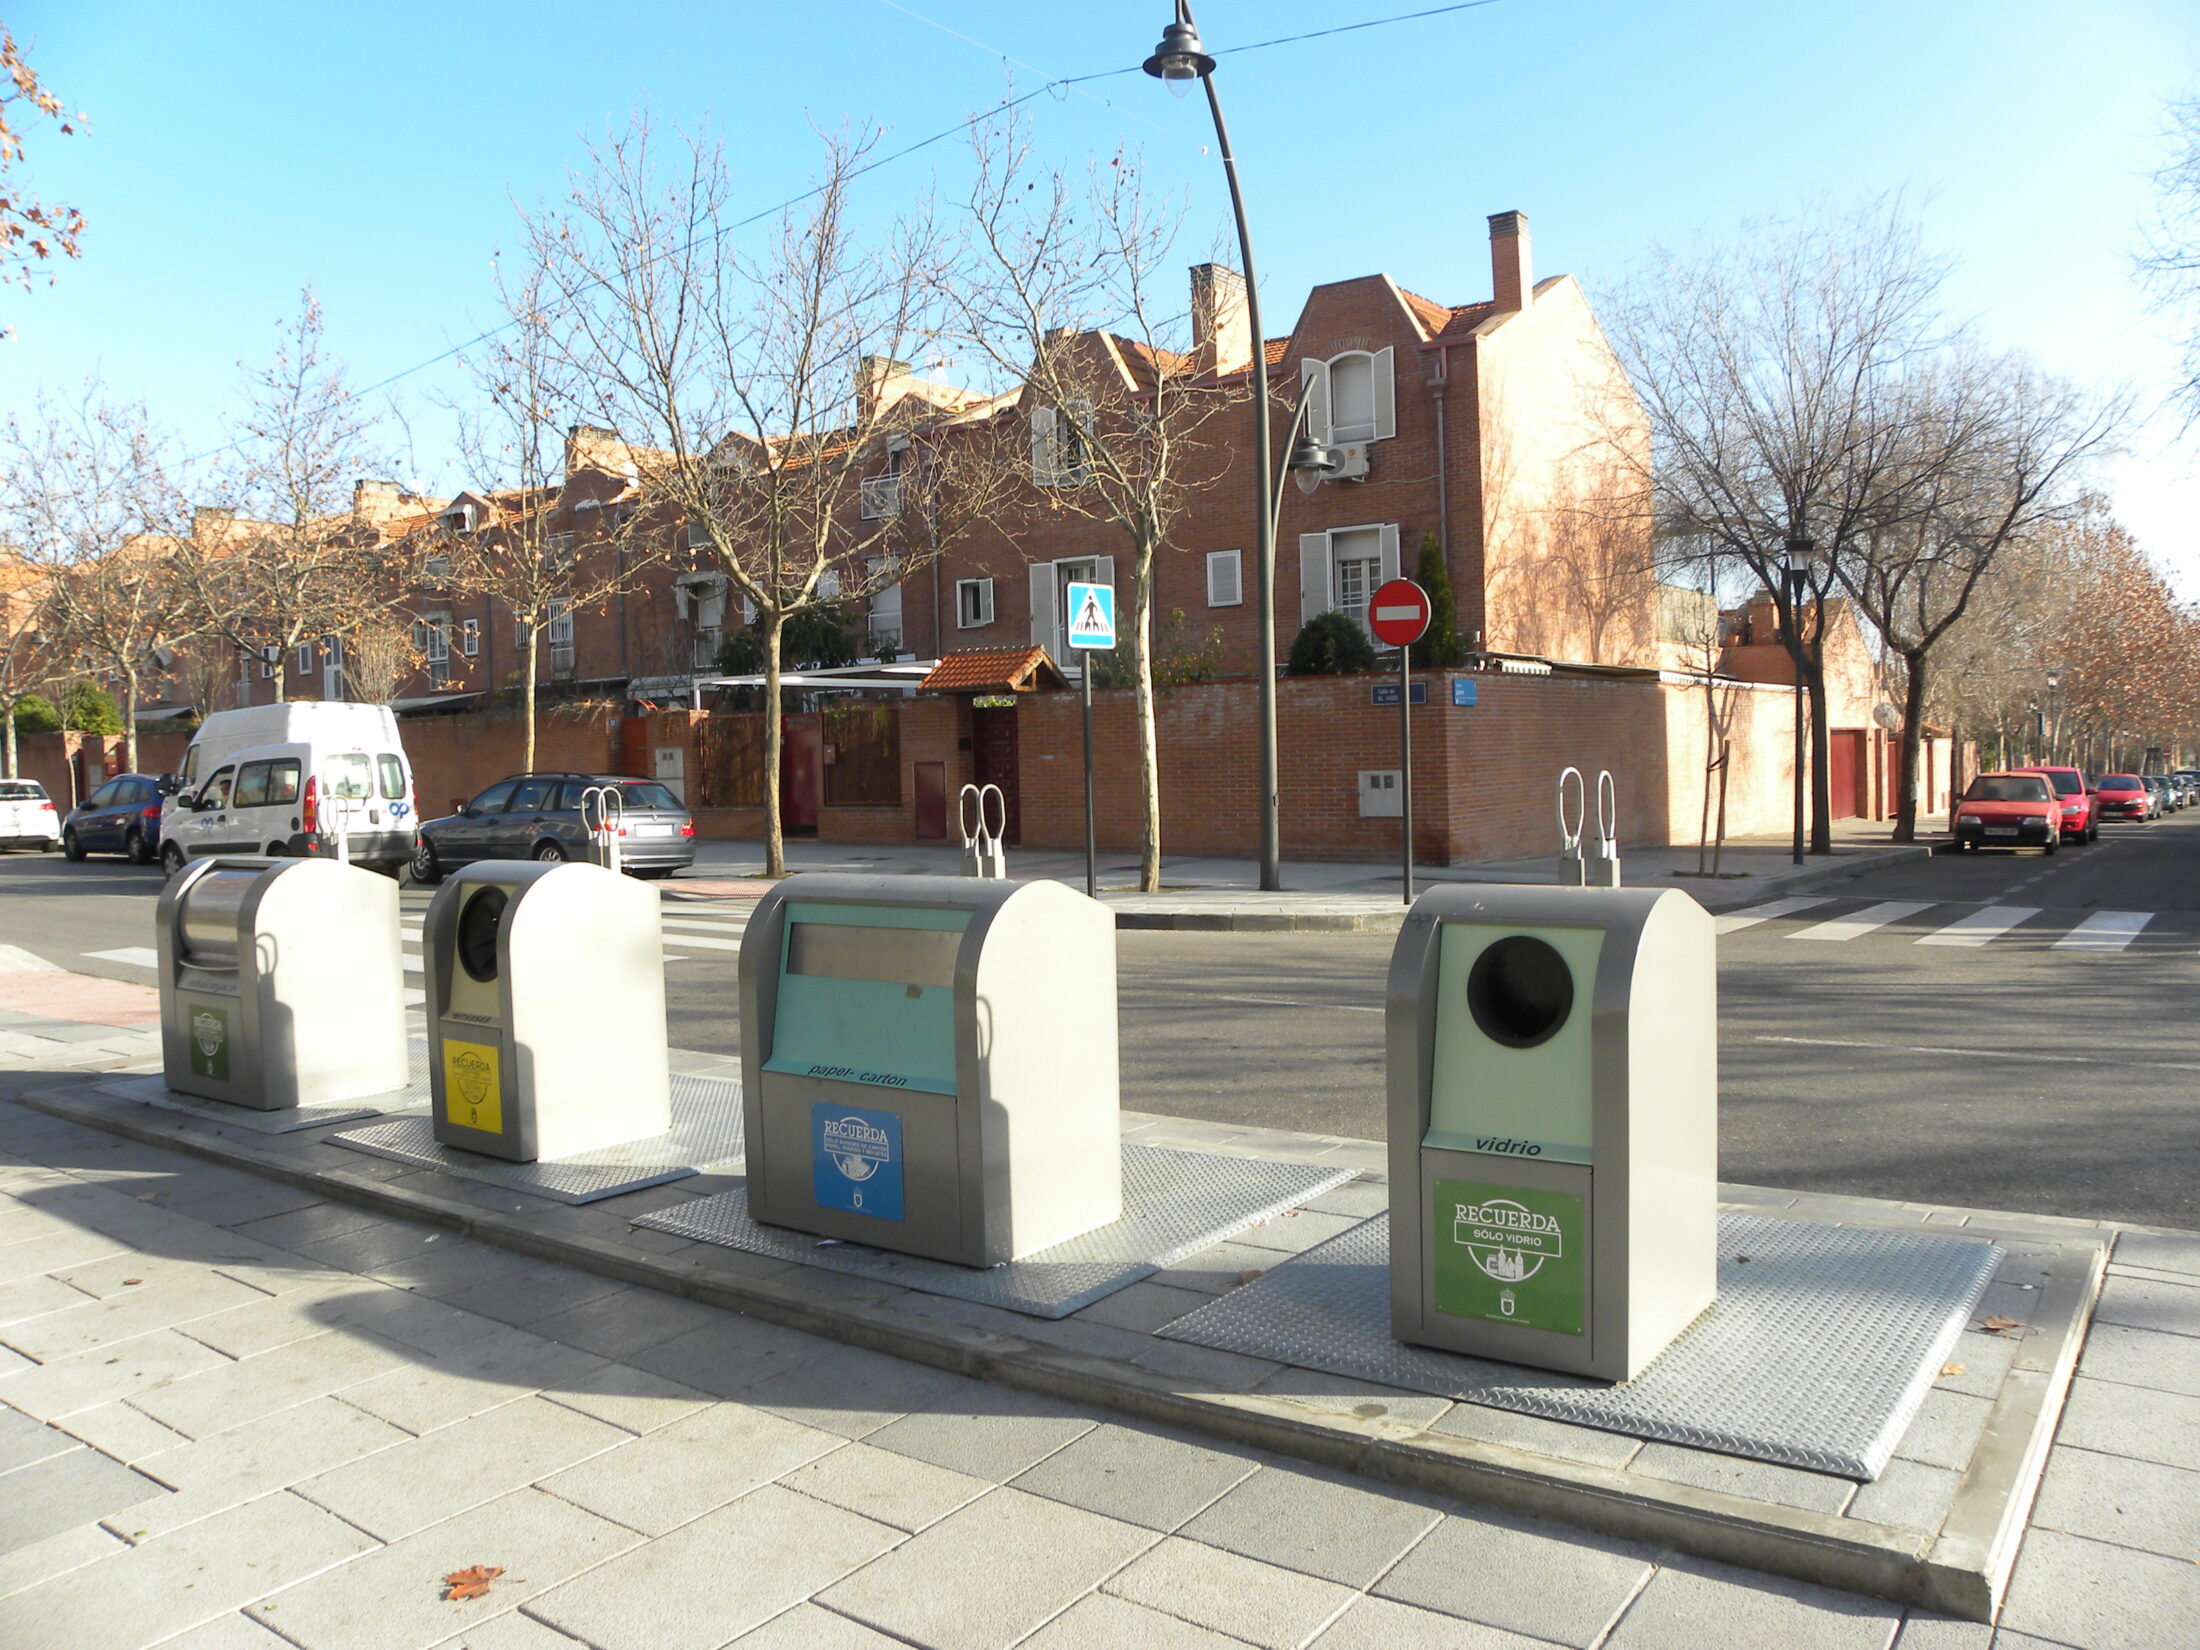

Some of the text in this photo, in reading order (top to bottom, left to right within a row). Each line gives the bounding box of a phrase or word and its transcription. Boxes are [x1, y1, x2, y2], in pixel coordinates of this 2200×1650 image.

[452, 1057, 490, 1071] RECUERDA
[859, 1071, 908, 1087] carton
[824, 1120, 889, 1143] RECUERDA
[1475, 1137, 1542, 1156] vidrio
[1455, 1203, 1562, 1233] RECUERDA
[1506, 1233, 1542, 1247] VIDRIO
